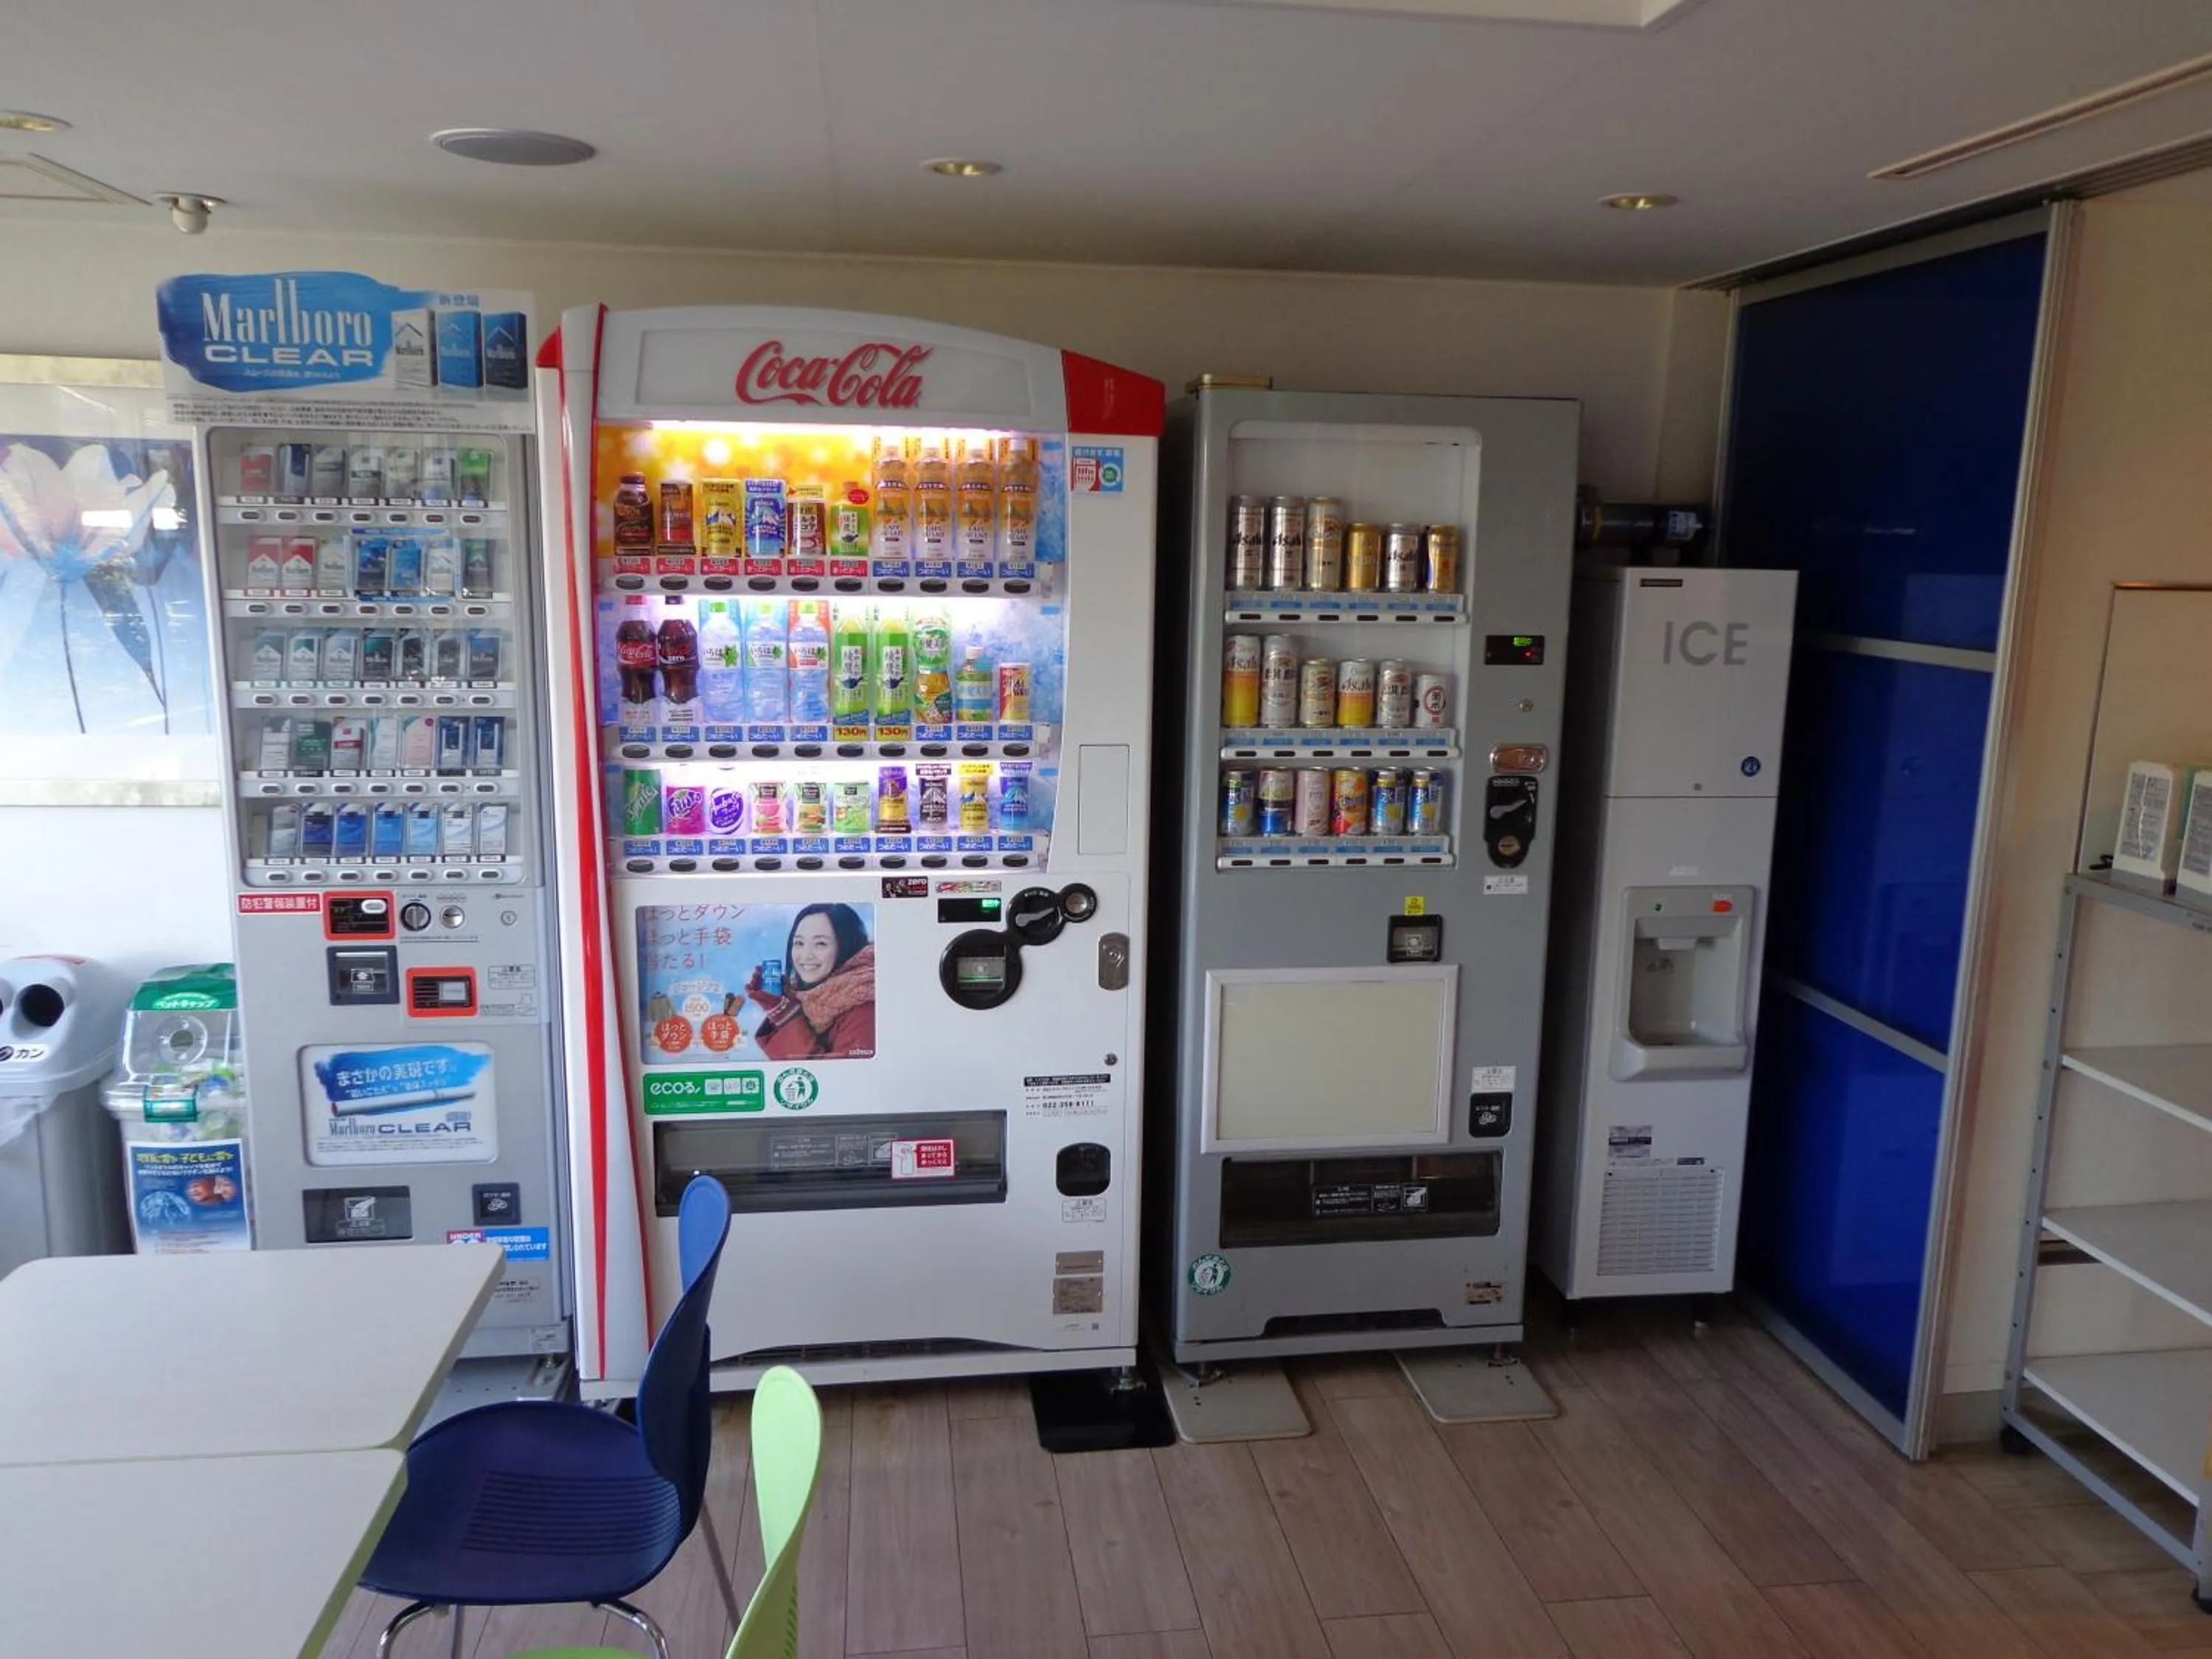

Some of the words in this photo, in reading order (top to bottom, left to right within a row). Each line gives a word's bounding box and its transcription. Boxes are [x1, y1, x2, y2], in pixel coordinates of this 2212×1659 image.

[201, 279, 372, 346] Marlboro
[205, 345, 374, 366] CLEAR
[1663, 621, 1749, 666] ICE
[240, 897, 318, 911] 防犯警報装置付
[15, 1046, 44, 1060] カン
[378, 1121, 472, 1134] CLEAR
